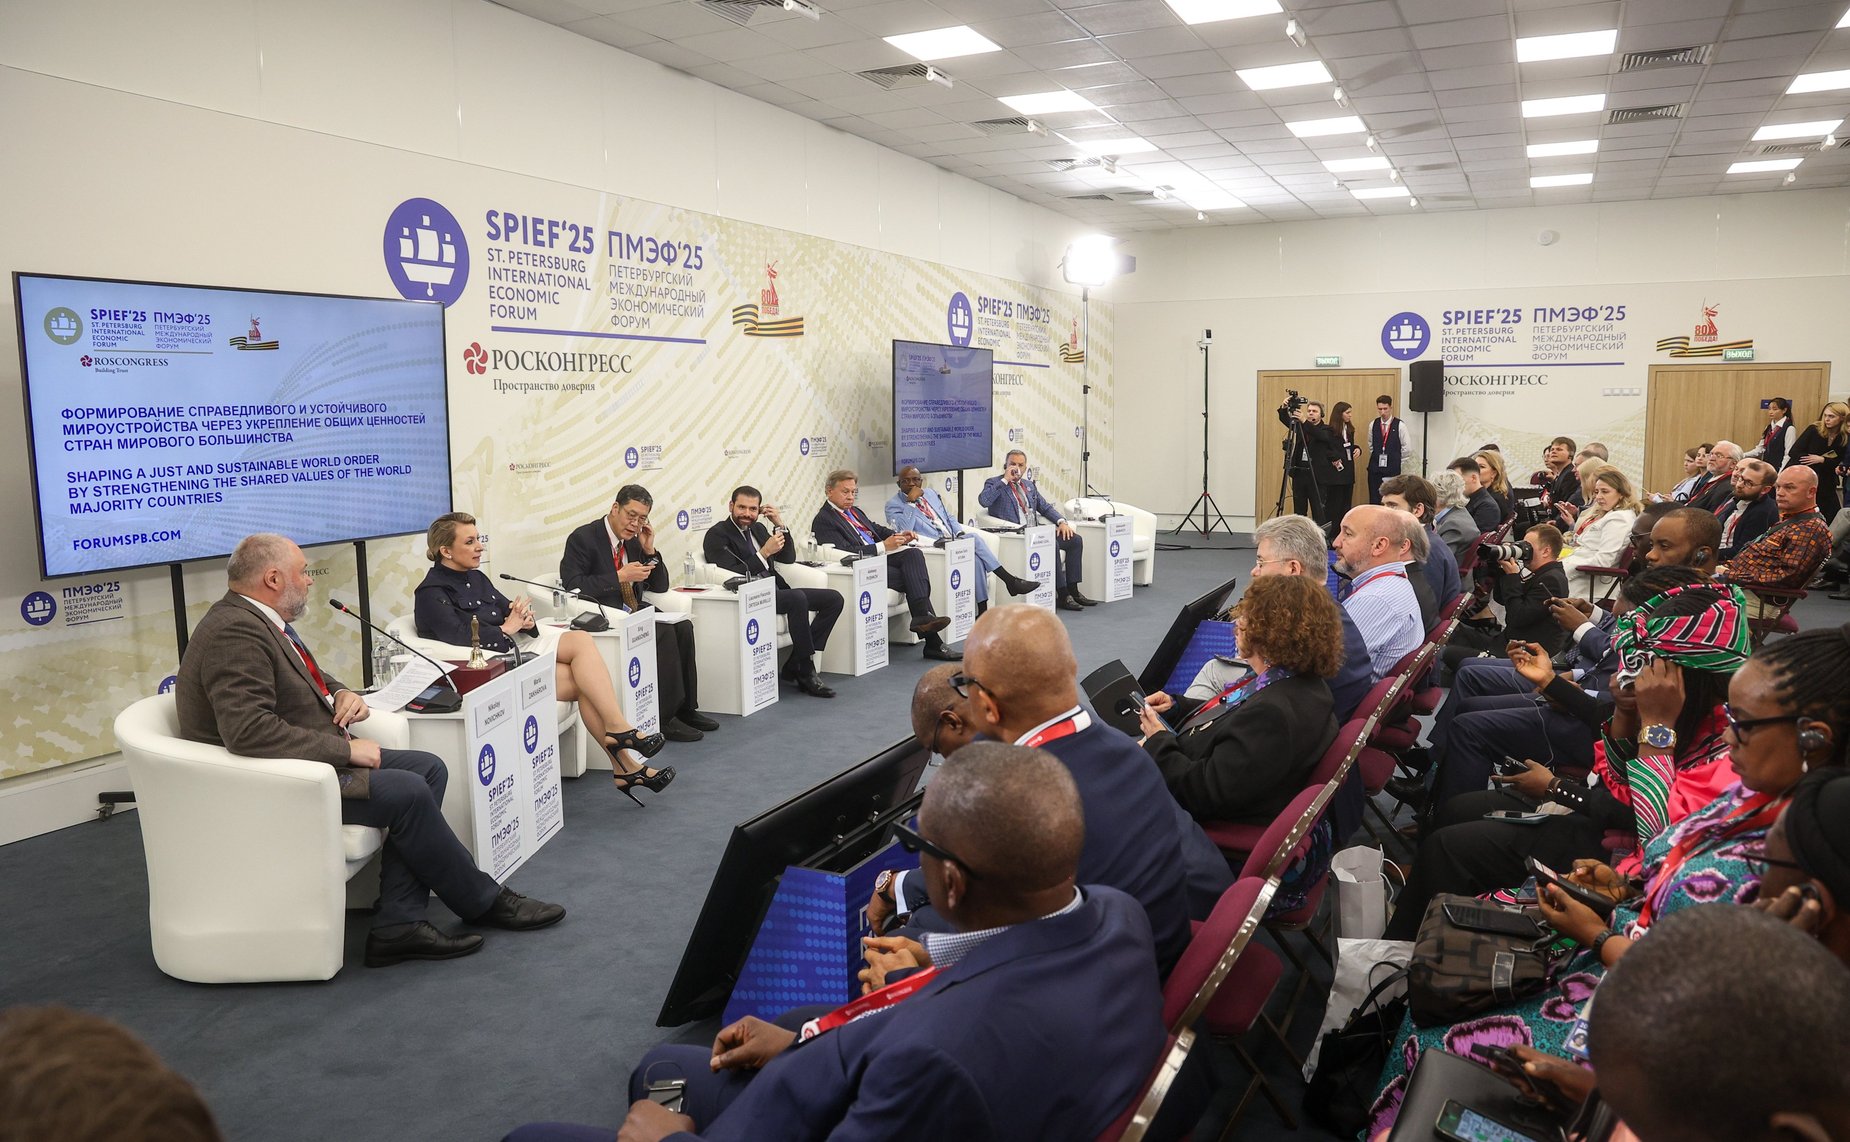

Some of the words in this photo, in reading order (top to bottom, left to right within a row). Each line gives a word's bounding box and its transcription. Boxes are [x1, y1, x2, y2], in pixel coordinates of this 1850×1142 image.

[486, 209, 594, 255] SPIEF'25
[487, 247, 505, 264] ST.
[508, 251, 586, 273] PETERSBURG
[488, 266, 591, 291] INTERNATIONAL
[609, 264, 693, 287] ПЕТЕРБУРГСКИЙ
[489, 286, 560, 305] ECONOMIC
[610, 281, 706, 304] МЕЖДУНАРОДНЫЙ
[490, 304, 537, 320] FORUM
[610, 298, 704, 318] ЭКОНОМИЧЕСКИЙ
[977, 295, 1013, 318] SPIEF'25
[90, 308, 147, 322] SPIEF'25
[153, 312, 211, 325] ПМЭФ'25
[610, 315, 650, 329] ФОРУМ
[1442, 308, 1522, 326] SPIEF'25
[101, 322, 143, 330] PETERSBURG
[154, 324, 205, 332] ПЕТЕРБУРГСКИЙ
[1442, 328, 1454, 336] ST.
[1456, 327, 1514, 336] PETERSBURG
[1532, 323, 1614, 334] ПЕТЕРБУРГСКИЙ
[1694, 325, 1707, 336] 80
[154, 330, 213, 338] МЕЖДУНАРОДНЫЙ
[977, 328, 1011, 339] INTERNATIONAL
[1441, 335, 1517, 344] INTERNATIONAL
[1532, 332, 1627, 343] МЕЖДУНАРОДНЫЙ
[1694, 335, 1718, 343] ПОБЕДА!
[1441, 345, 1492, 353] ECONOMIC
[1532, 342, 1624, 352] ЭКОНОМИЧЕСКИЙ
[491, 349, 633, 374] РОСКОНГРЕСС
[1441, 354, 1474, 362] FORUM
[1532, 352, 1568, 361] ФОРУМ
[1726, 350, 1753, 359] ВЫХОД
[94, 357, 169, 367] ROSCONGRESS
[493, 378, 560, 394] Пространство
[561, 382, 596, 395] доверия
[1443, 389, 1486, 398] ространство
[1487, 389, 1515, 397] доверия
[61, 406, 185, 420] ФОРМИРОВАНИЕ
[188, 404, 296, 417] СПРАВЕДЛИВОГО
[299, 404, 307, 415] И
[309, 401, 387, 414] УСТОЙЧИВОГО
[62, 419, 198, 436] МИРОУСТРОЙСТВА
[201, 419, 242, 431] ЧЕРЕЗ
[246, 417, 321, 430] УКРЕПЛЕНИЕ
[324, 416, 364, 428] ОБЩИХ
[366, 413, 426, 427] ЦЕННОСТЕЙ
[64, 439, 113, 451] СТРАН
[117, 435, 195, 450] МИРОВОГО
[199, 432, 294, 446] БОЛЬШИНСТВА
[66, 468, 133, 484] SHAPING
[136, 468, 146, 479] A
[149, 465, 183, 479] JUST
[186, 464, 213, 476] AND
[217, 459, 299, 474] SUSTAINABLE
[301, 457, 341, 469] WORLD
[343, 454, 380, 466] ORDER
[68, 486, 89, 499] BY
[93, 478, 210, 498] STRENGTHENING
[213, 476, 237, 488] THE
[240, 473, 289, 487] SHARED
[291, 470, 335, 482] VALUES
[337, 469, 351, 479] OF
[354, 467, 374, 478] THE
[376, 465, 412, 476] WORLD
[70, 498, 144, 515] MAJORITY
[147, 492, 223, 508] COUNTRIES
[73, 530, 181, 550] FORUMSPB.COM
[62, 581, 120, 599] ПМЭФ'25
[63, 592, 115, 605] ПЕТЕРБУРГСКИЙ
[64, 597, 123, 611] МЕЖДУНАРОДНЫЙ
[65, 604, 122, 617] ЭКОНОМИЧЕСКИЙ
[65, 614, 89, 622] ФОРУМ
[753, 642, 772, 656] SPIEF'25
[635, 682, 654, 701] SPIEF'25
[532, 744, 554, 769] SPIEF'25
[488, 773, 515, 802] SPIEF'25
